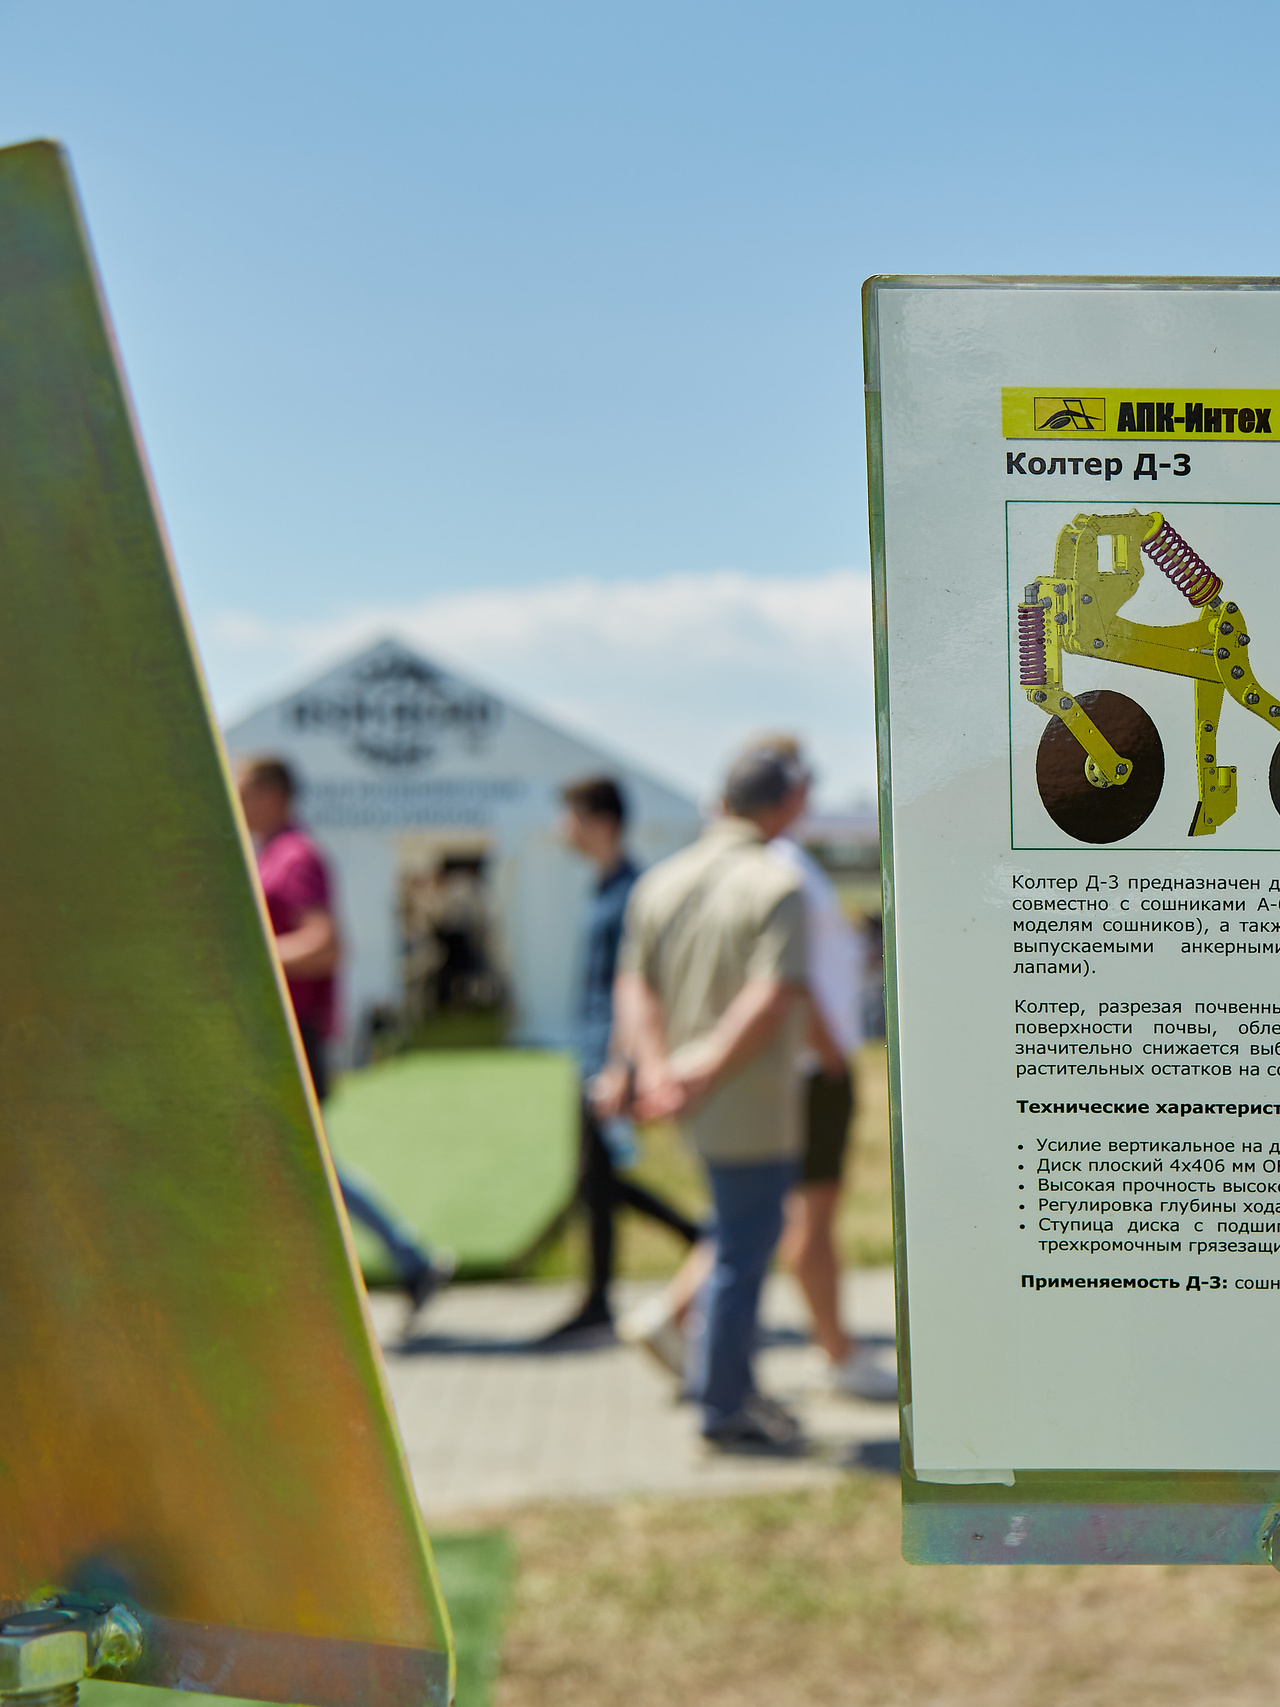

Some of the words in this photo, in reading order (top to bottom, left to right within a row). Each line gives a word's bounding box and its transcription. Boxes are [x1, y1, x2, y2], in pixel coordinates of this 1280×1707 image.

[1117, 402, 1272, 433] АПК-Интех
[1006, 452, 1123, 481] Колтер
[1133, 453, 1192, 480] Д-3
[1012, 874, 1078, 893] Колтер
[1085, 874, 1119, 893] Д-3
[1128, 877, 1261, 893] предназначен
[1011, 899, 1109, 912] совместно
[1119, 899, 1130, 911] с
[1140, 899, 1246, 912] сошниками
[1013, 920, 1093, 935] моделям
[1102, 917, 1209, 936] сошников),
[1219, 920, 1230, 933] а
[1013, 941, 1154, 957] выпускаемыми
[1012, 959, 1096, 978] лапами).
[1014, 999, 1086, 1017] Колтер,
[1098, 1001, 1182, 1017] разрезая
[1015, 1022, 1133, 1038] поверхности
[1153, 1022, 1218, 1038] почвы,
[1014, 1043, 1133, 1055] значительно
[1142, 1043, 1239, 1056] снижается
[1016, 1064, 1145, 1079] растительных
[1150, 1064, 1233, 1076] остатков
[1239, 1064, 1260, 1077] на
[1015, 1099, 1150, 1115] Технические
[1035, 1137, 1102, 1152] Усилие
[1108, 1140, 1236, 1156] вертикальное
[1241, 1141, 1263, 1153] на
[1036, 1157, 1083, 1175] Диск
[1088, 1157, 1163, 1173] плоский
[1232, 1161, 1256, 1173] мм
[1038, 1177, 1115, 1192] Высокая
[1122, 1180, 1216, 1196] прочность
[1038, 1197, 1153, 1215] Регулировка
[1160, 1198, 1237, 1216] глубины
[1038, 1217, 1114, 1235] Ступица
[1126, 1220, 1180, 1234] диска
[1193, 1221, 1204, 1233] с
[1037, 1240, 1182, 1255] трехкромочным
[1021, 1274, 1181, 1292] Применяемость
[1185, 1275, 1228, 1292] Д-3:
